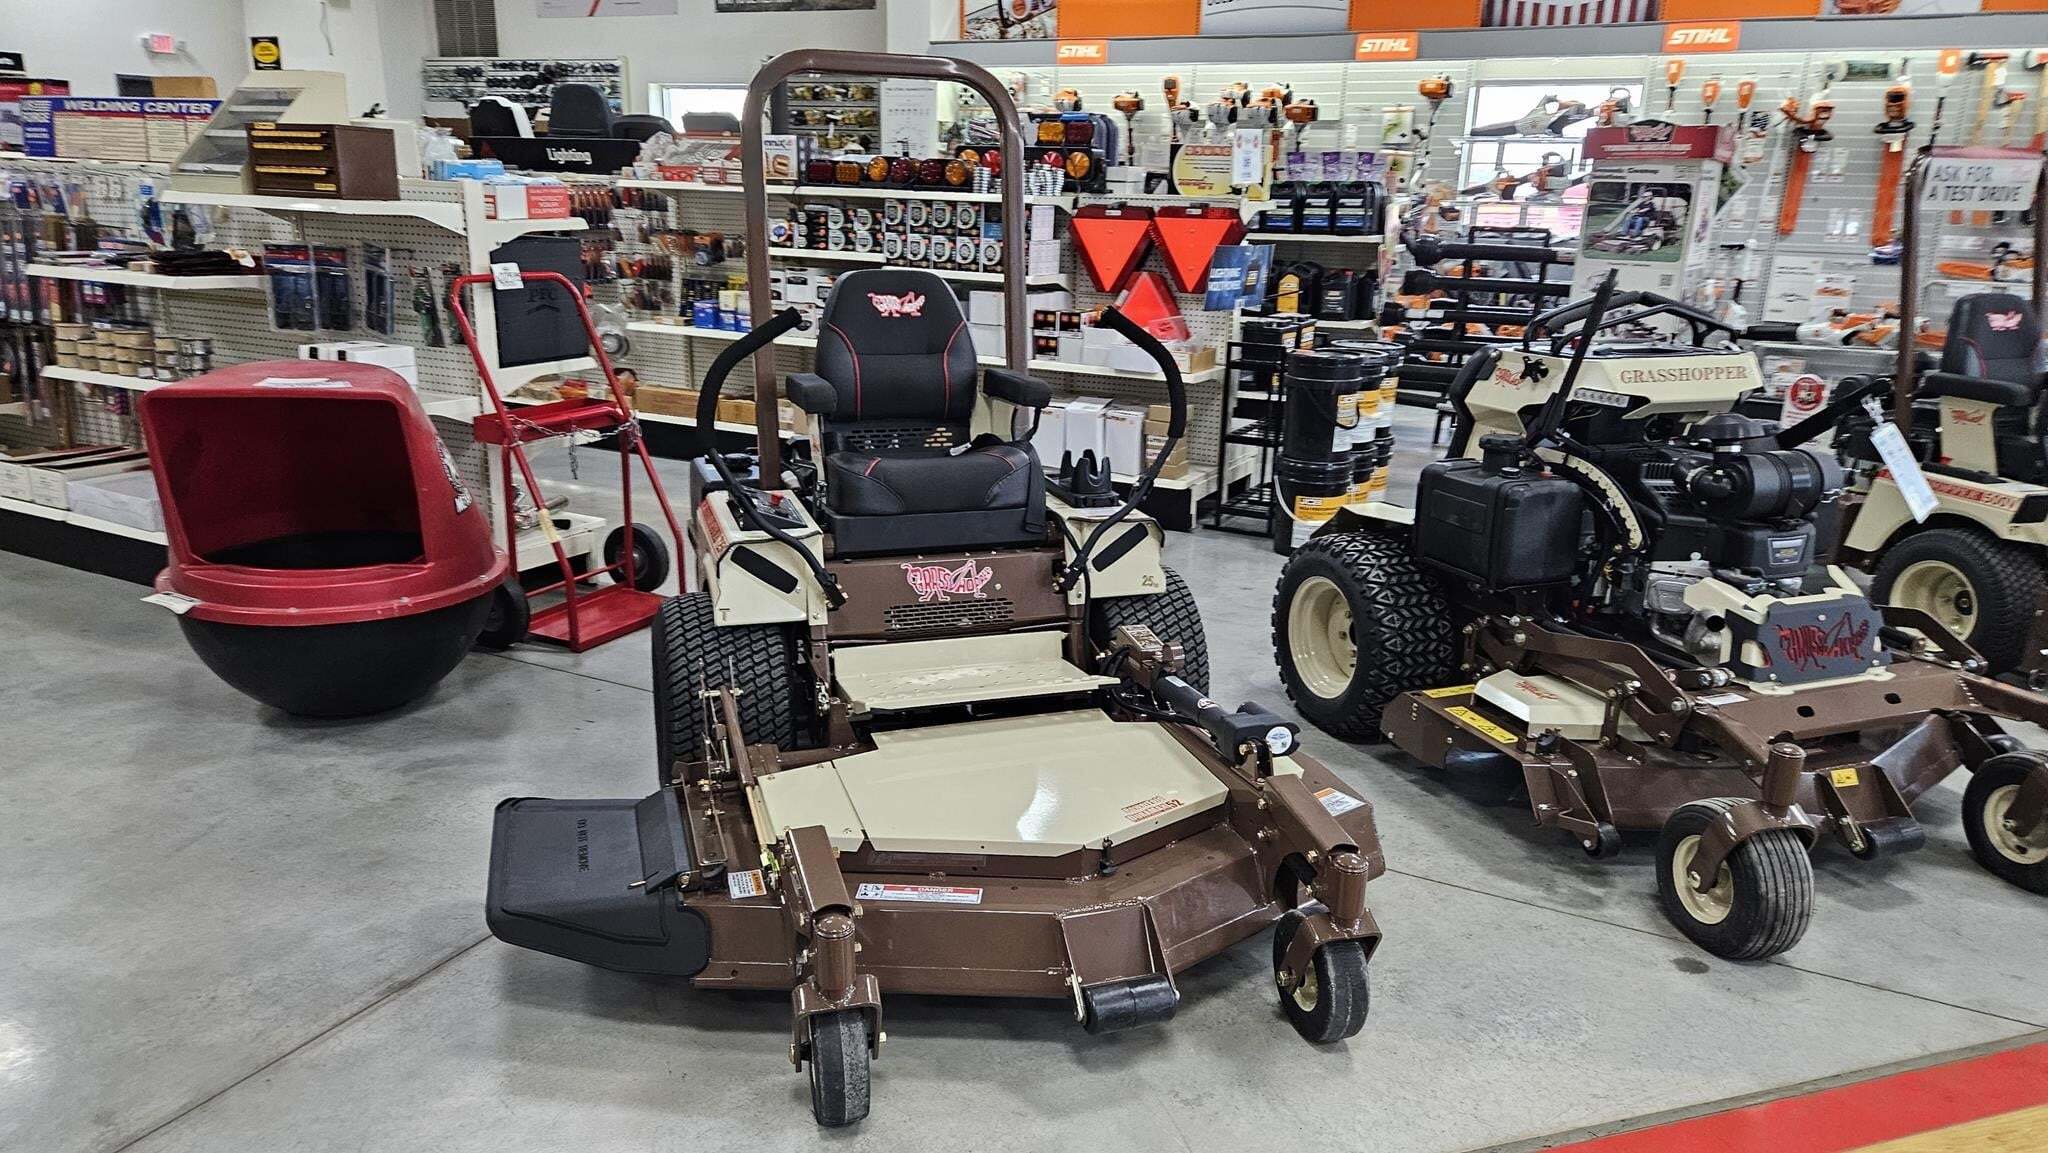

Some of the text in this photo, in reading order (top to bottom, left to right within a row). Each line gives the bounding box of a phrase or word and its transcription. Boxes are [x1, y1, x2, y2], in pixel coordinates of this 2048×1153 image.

[1669, 28, 1732, 45] STIHL
[1058, 45, 1101, 58] STIHL
[1359, 38, 1411, 53] STIHL
[63, 99, 141, 113] WELDING
[143, 102, 213, 114] CENTER
[546, 147, 593, 164] Lighting
[1933, 165, 1994, 183] ASK FOR
[1926, 185, 2023, 203] A TEST DRIVE
[1620, 365, 1749, 385] GRASSHOPPER
[1141, 574, 1155, 587] 25
[1165, 799, 1185, 808] 52
